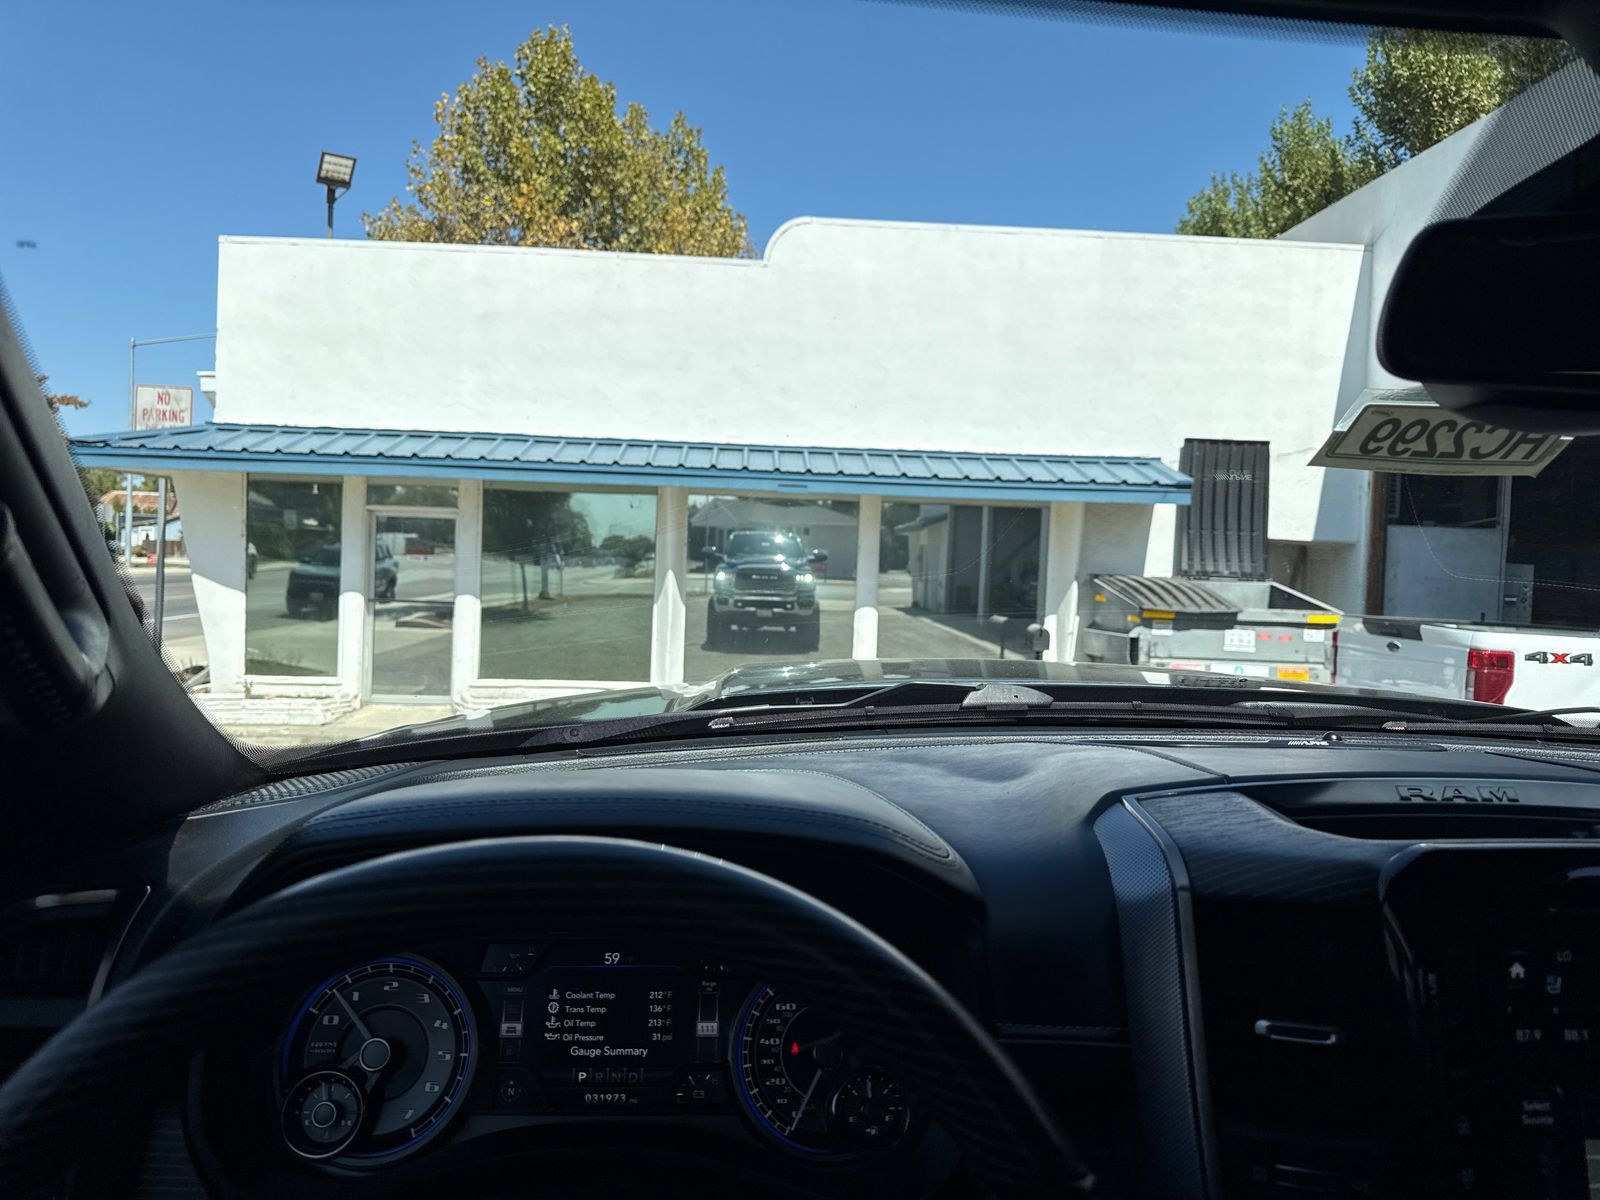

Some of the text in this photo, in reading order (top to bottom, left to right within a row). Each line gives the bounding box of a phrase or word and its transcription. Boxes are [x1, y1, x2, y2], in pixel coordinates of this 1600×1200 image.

[157, 391, 171, 405] NO
[142, 408, 185, 423] PARKING
[1394, 784, 1521, 803] RAM
[603, 952, 621, 965] 59
[383, 981, 400, 991] 2
[415, 993, 430, 1004] 3
[565, 991, 594, 1000] Coolant
[594, 991, 616, 1000] Temp
[564, 1005, 585, 1013] Trans
[585, 1005, 607, 1014] Temp
[775, 1002, 797, 1011] 60
[322, 1014, 340, 1026] 0
[433, 1019, 449, 1030] 4
[563, 1019, 575, 1027] Oil
[575, 1019, 597, 1028] Temp
[562, 1033, 574, 1041] Oil
[574, 1033, 604, 1041] Pressure
[651, 1032, 661, 1041] 31
[759, 1037, 781, 1046] 40
[437, 1050, 451, 1061] 5
[570, 1045, 648, 1058] Gauge Summary
[578, 1071, 587, 1083] P
[765, 1077, 786, 1086] 20
[424, 1081, 440, 1093] 6
[584, 1093, 627, 1104] 031973
